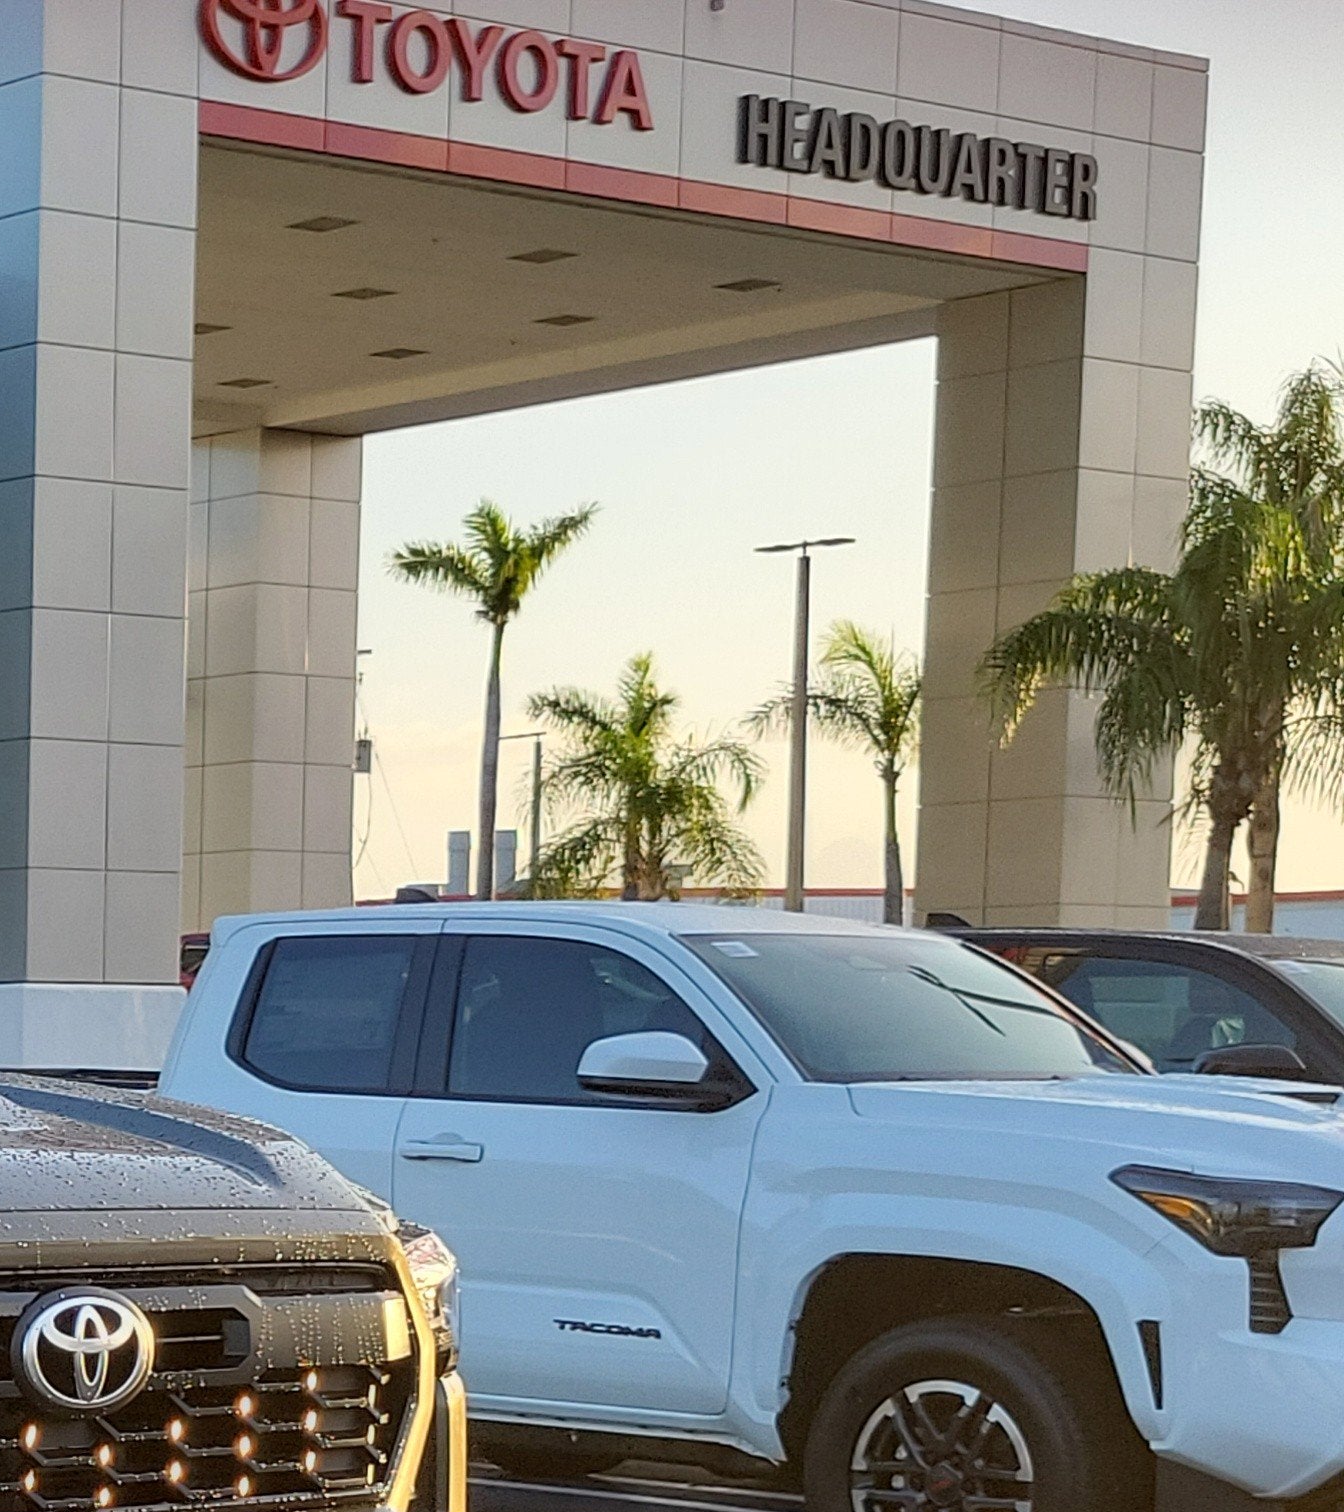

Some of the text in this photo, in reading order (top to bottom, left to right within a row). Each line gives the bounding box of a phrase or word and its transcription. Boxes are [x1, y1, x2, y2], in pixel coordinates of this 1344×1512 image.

[336, 0, 1099, 221] TOYOTA HEADQUARTER
[553, 1318, 662, 1340] TACOMA
